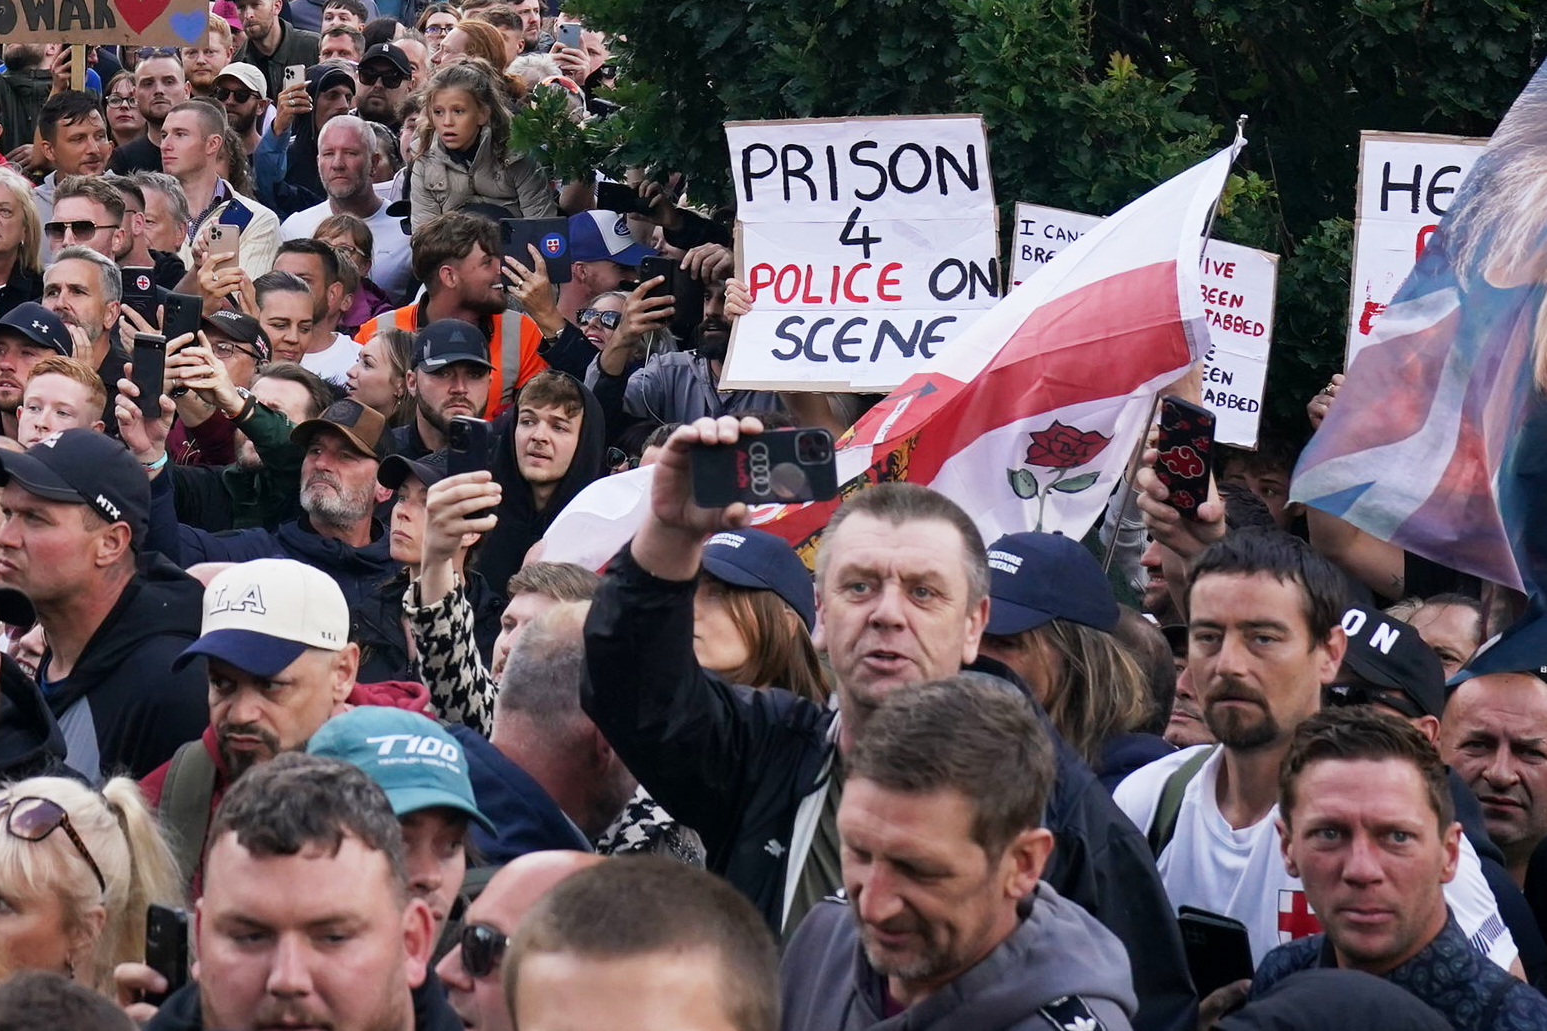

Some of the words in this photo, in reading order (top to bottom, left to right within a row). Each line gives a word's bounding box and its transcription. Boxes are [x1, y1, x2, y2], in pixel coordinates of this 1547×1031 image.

[741, 140, 979, 202] PRISON
[1380, 161, 1461, 216] HE
[839, 206, 882, 259] 4
[1019, 220, 1036, 236] I
[750, 262, 903, 304] POLICE
[928, 257, 998, 300] ON
[771, 315, 957, 362] SCENE
[1203, 308, 1265, 338] TABBED
[1202, 363, 1233, 386] EEN
[1202, 388, 1259, 414] ABBED
[96, 493, 121, 520] MTX
[209, 583, 267, 616] LA
[1341, 608, 1401, 655] ON
[366, 734, 459, 762] T100
